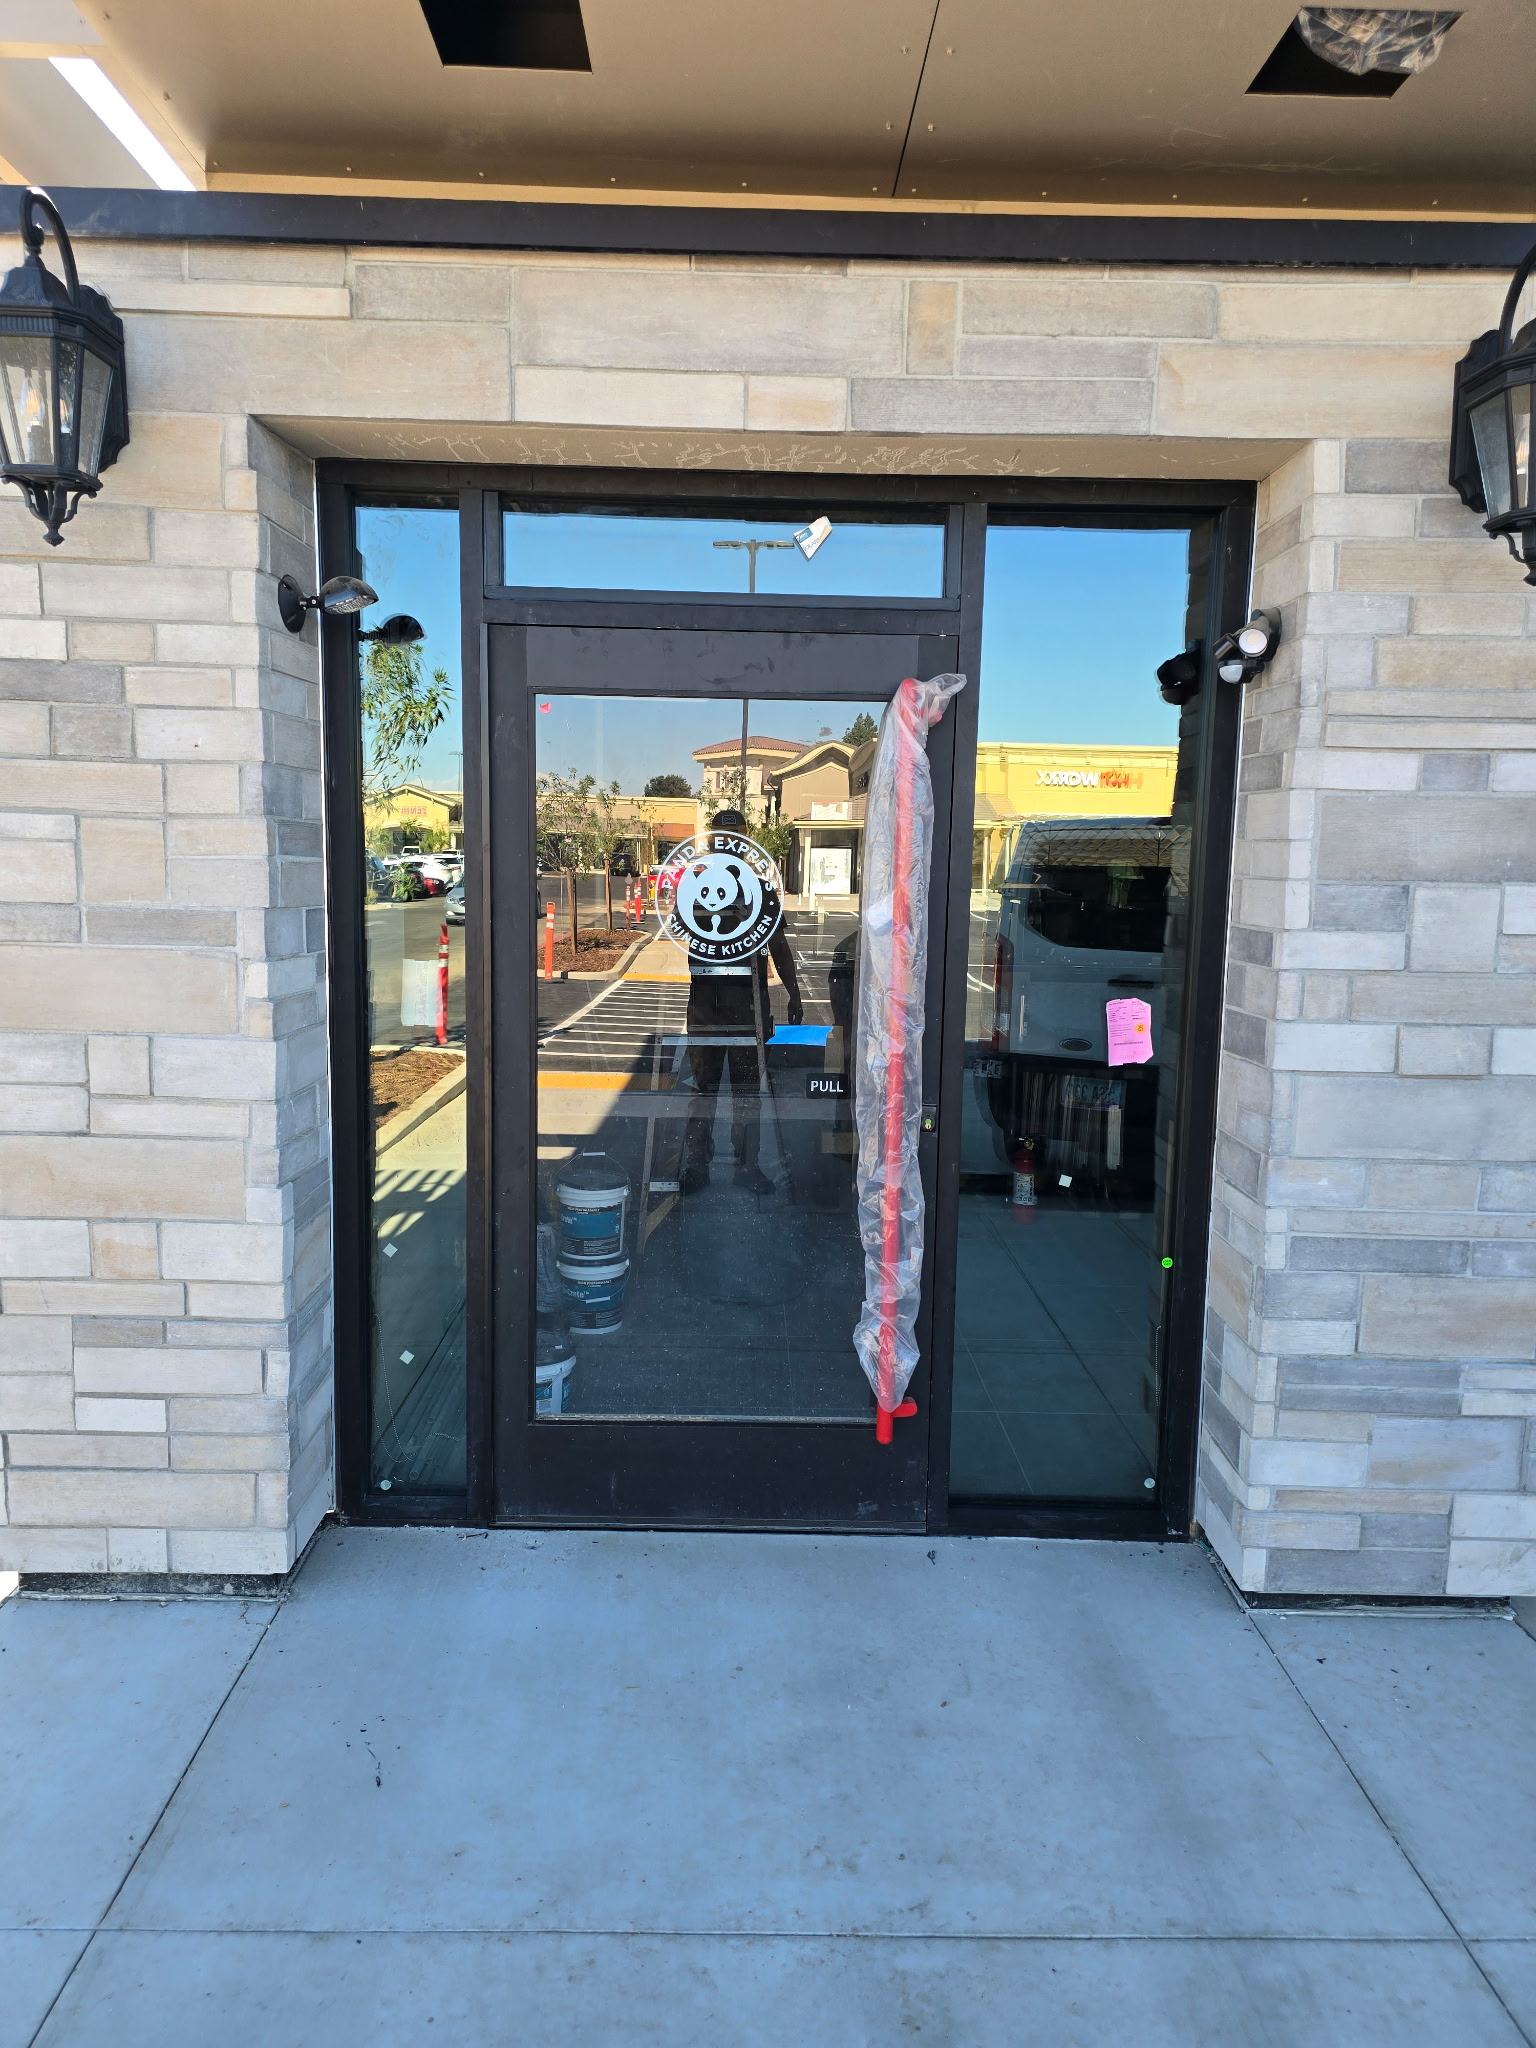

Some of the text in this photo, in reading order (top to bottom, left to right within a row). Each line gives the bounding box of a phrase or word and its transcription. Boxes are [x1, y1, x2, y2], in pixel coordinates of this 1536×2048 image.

[661, 840, 710, 889] PANDA
[667, 913, 773, 955] CHINESE KITCHEN
[810, 1080, 844, 1092] PULL
